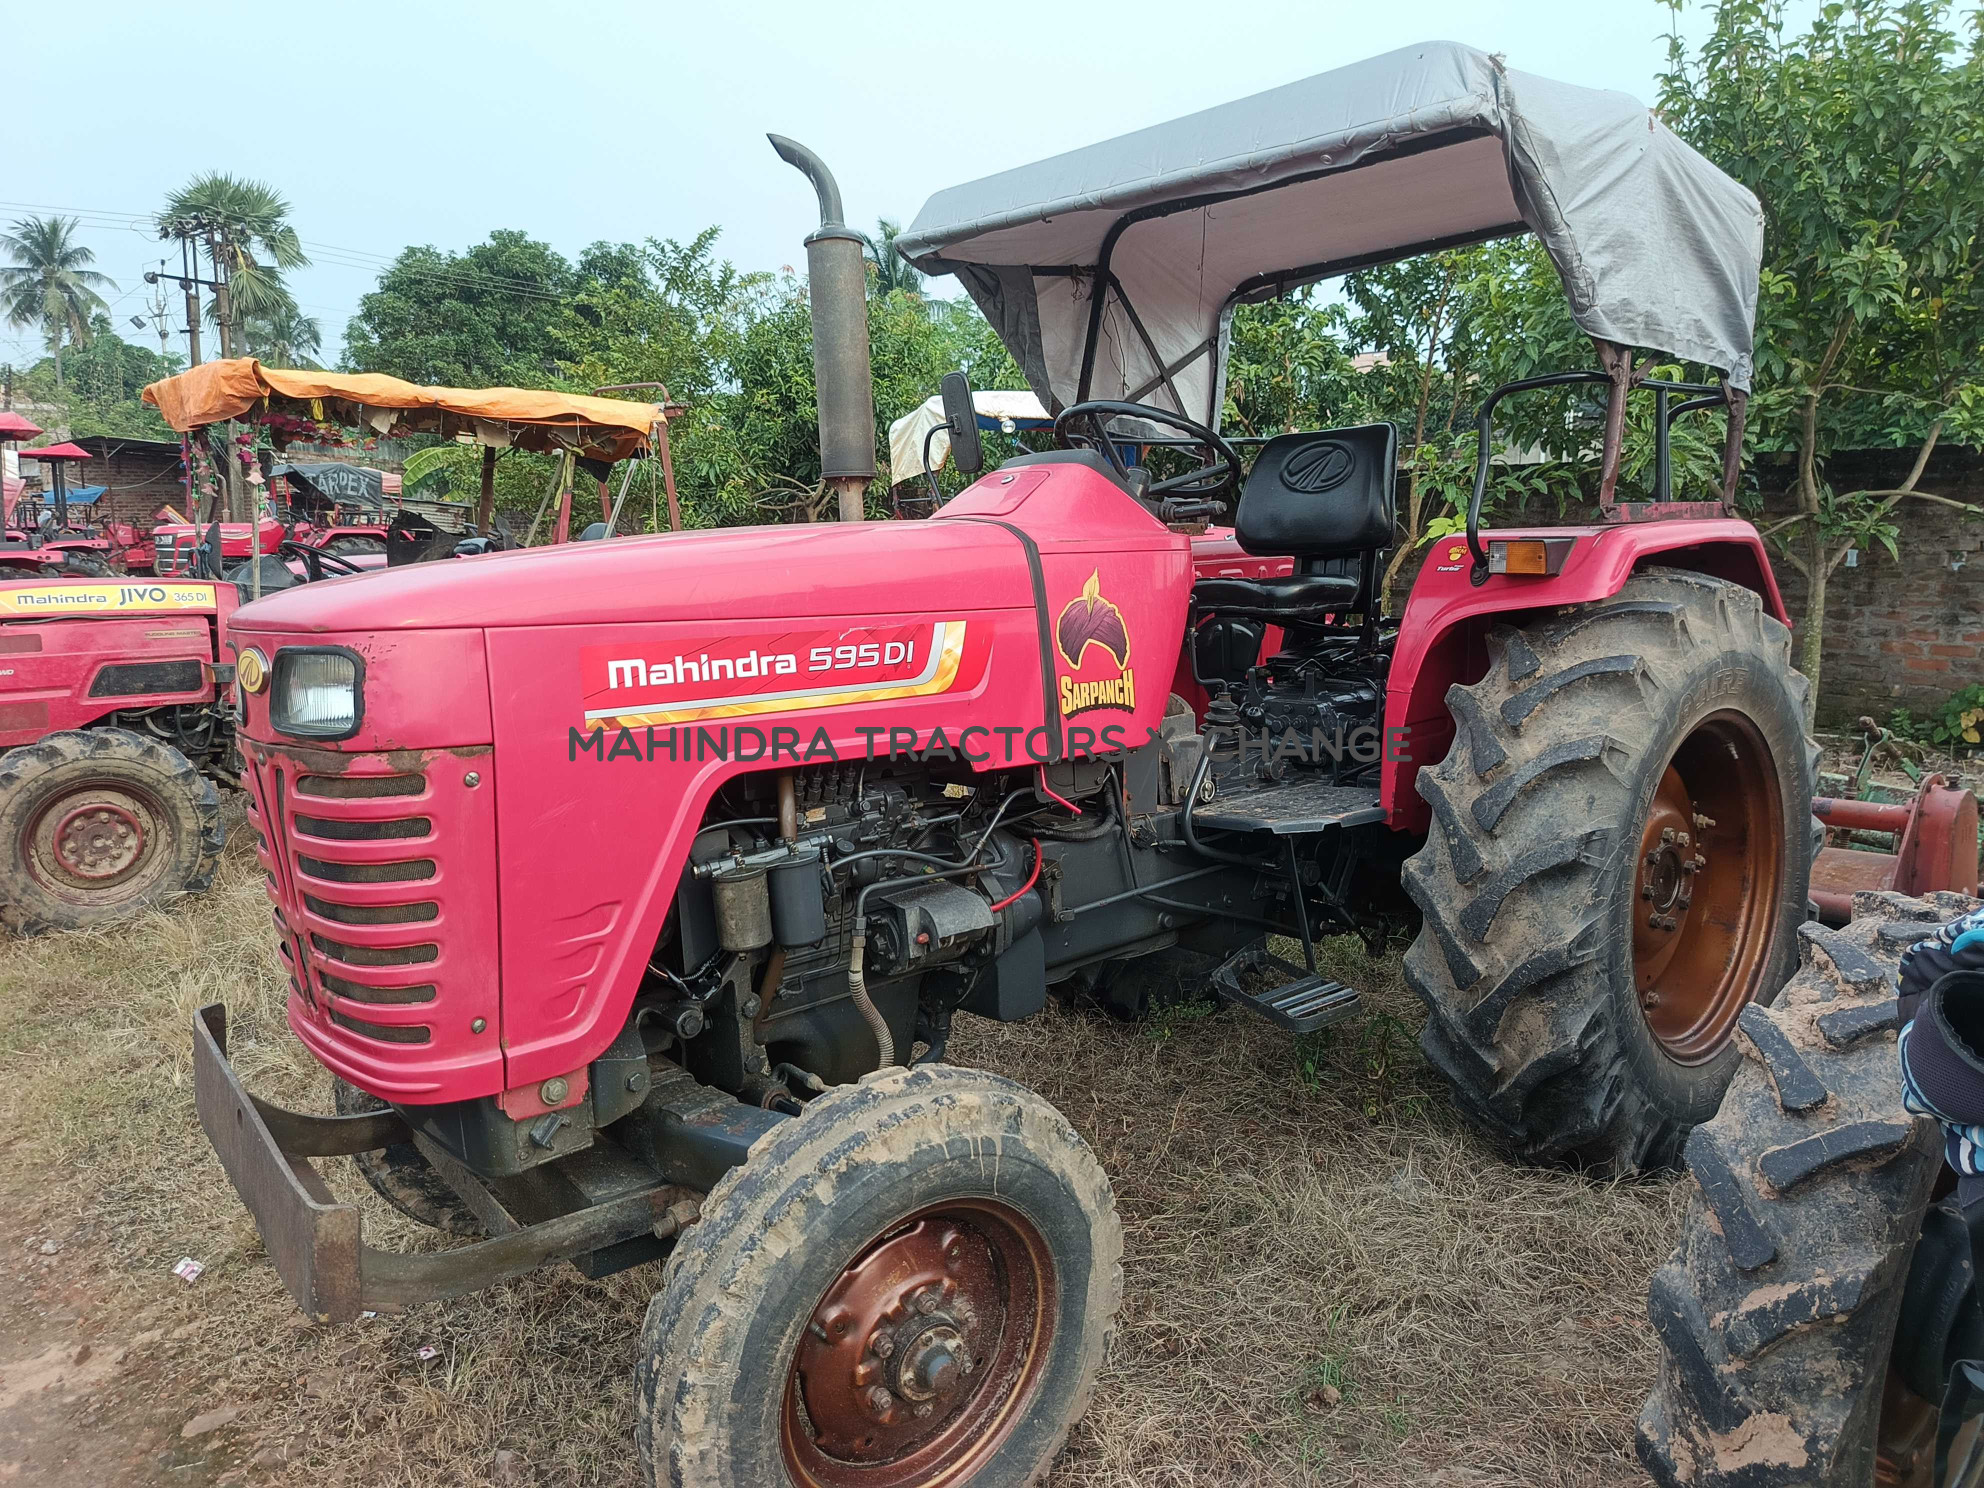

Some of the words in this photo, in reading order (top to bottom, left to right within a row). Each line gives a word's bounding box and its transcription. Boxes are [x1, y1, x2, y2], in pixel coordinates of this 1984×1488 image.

[17, 594, 107, 604] Mahindra
[119, 587, 166, 606] JIVO
[174, 592, 194, 602] 365
[607, 650, 798, 690] Mahindra
[1060, 668, 1136, 716] SARPANCH
